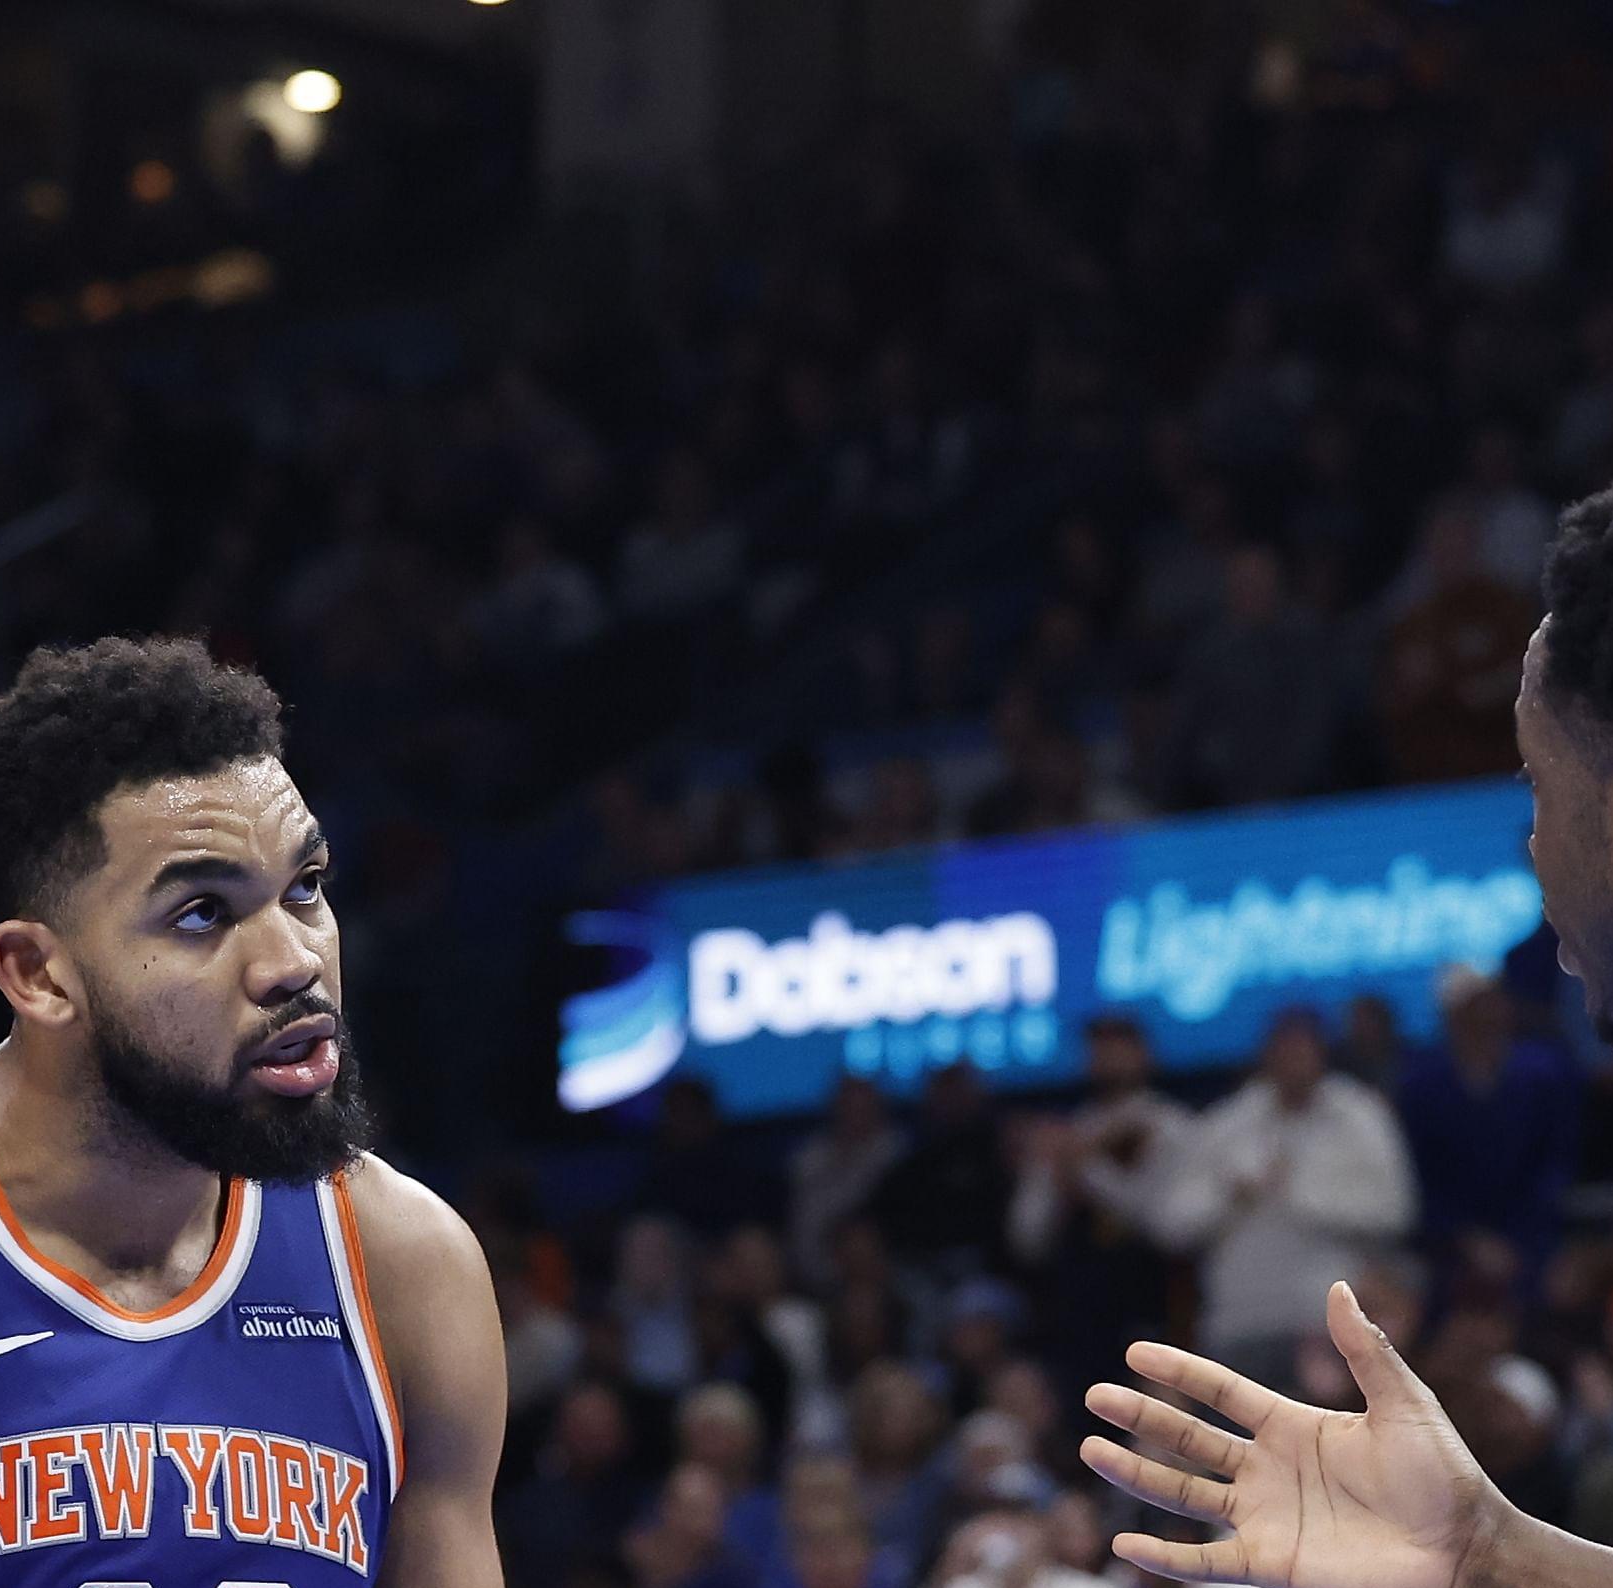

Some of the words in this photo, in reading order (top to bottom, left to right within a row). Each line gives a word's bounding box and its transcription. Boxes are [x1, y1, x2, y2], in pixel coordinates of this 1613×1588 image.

[689, 910, 1057, 1045] Dobson
[239, 1305, 295, 1316] experience
[242, 1316, 284, 1337] abu
[286, 1316, 341, 1340] dhabi
[154, 1421, 369, 1577] YORK
